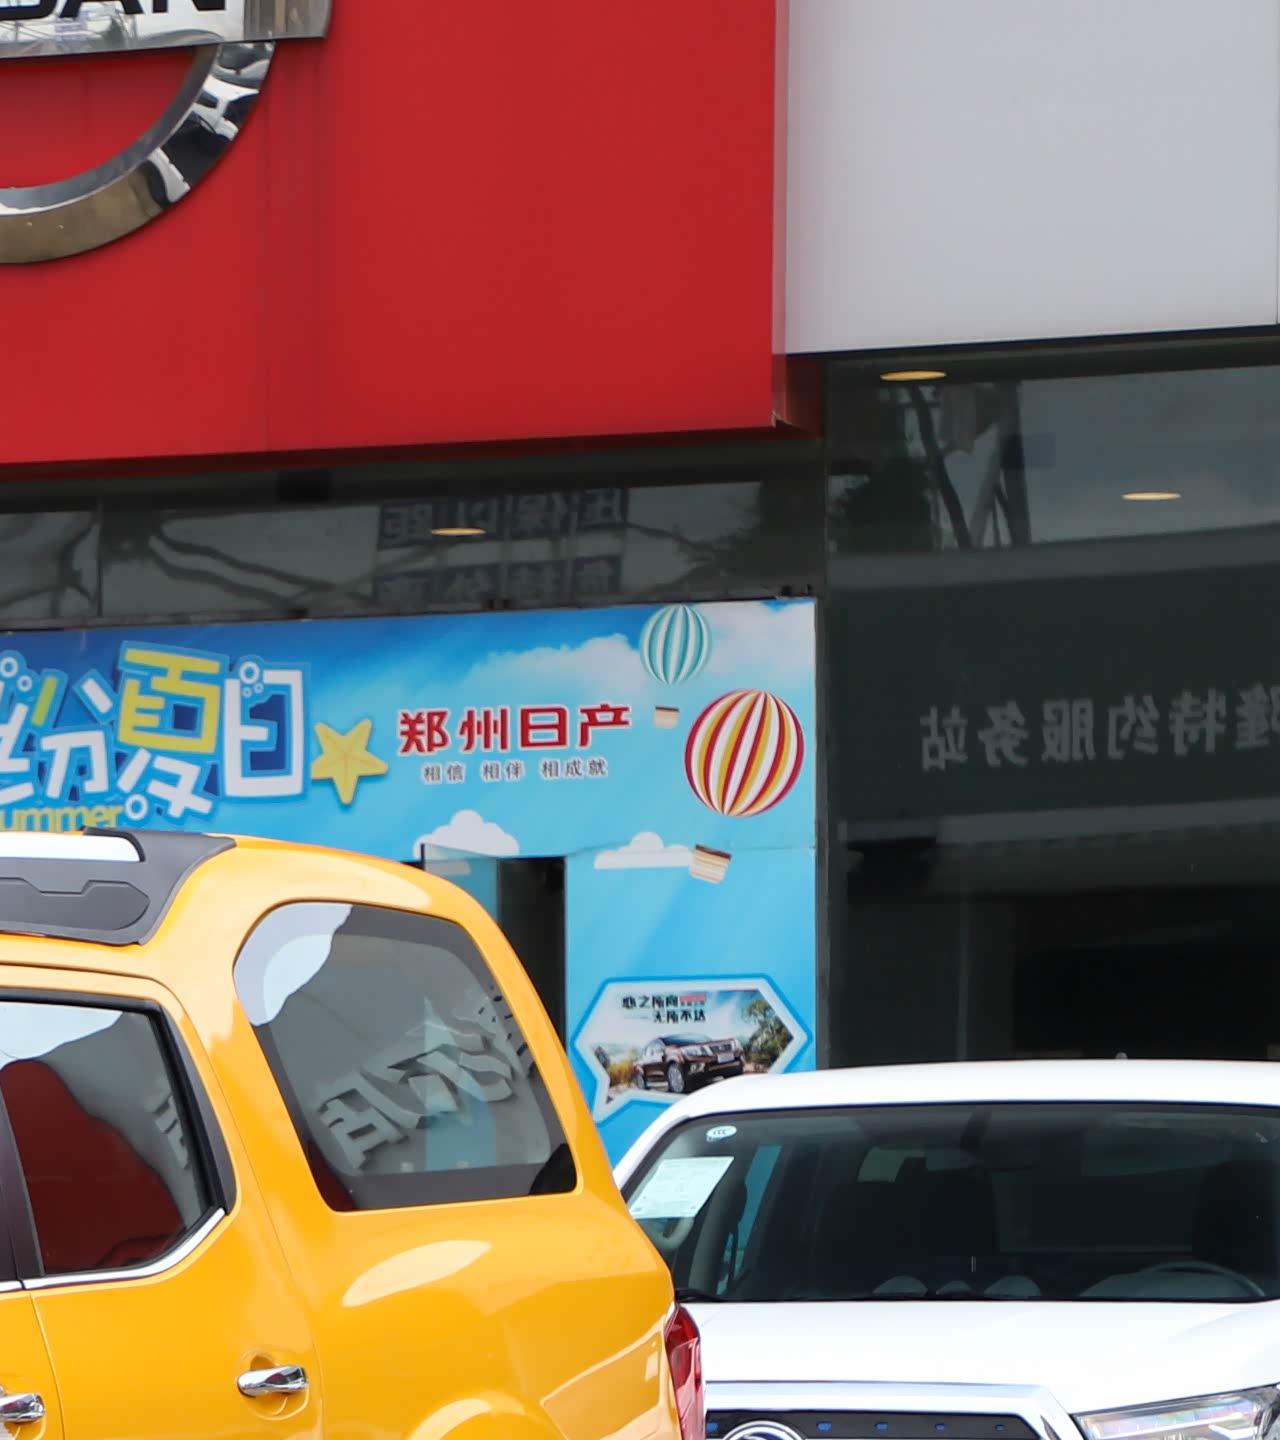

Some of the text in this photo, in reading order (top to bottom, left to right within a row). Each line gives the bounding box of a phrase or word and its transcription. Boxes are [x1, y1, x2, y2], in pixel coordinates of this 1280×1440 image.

[398, 702, 631, 755] 郑州日产
[423, 757, 607, 783] 相信 相伴 相成就
